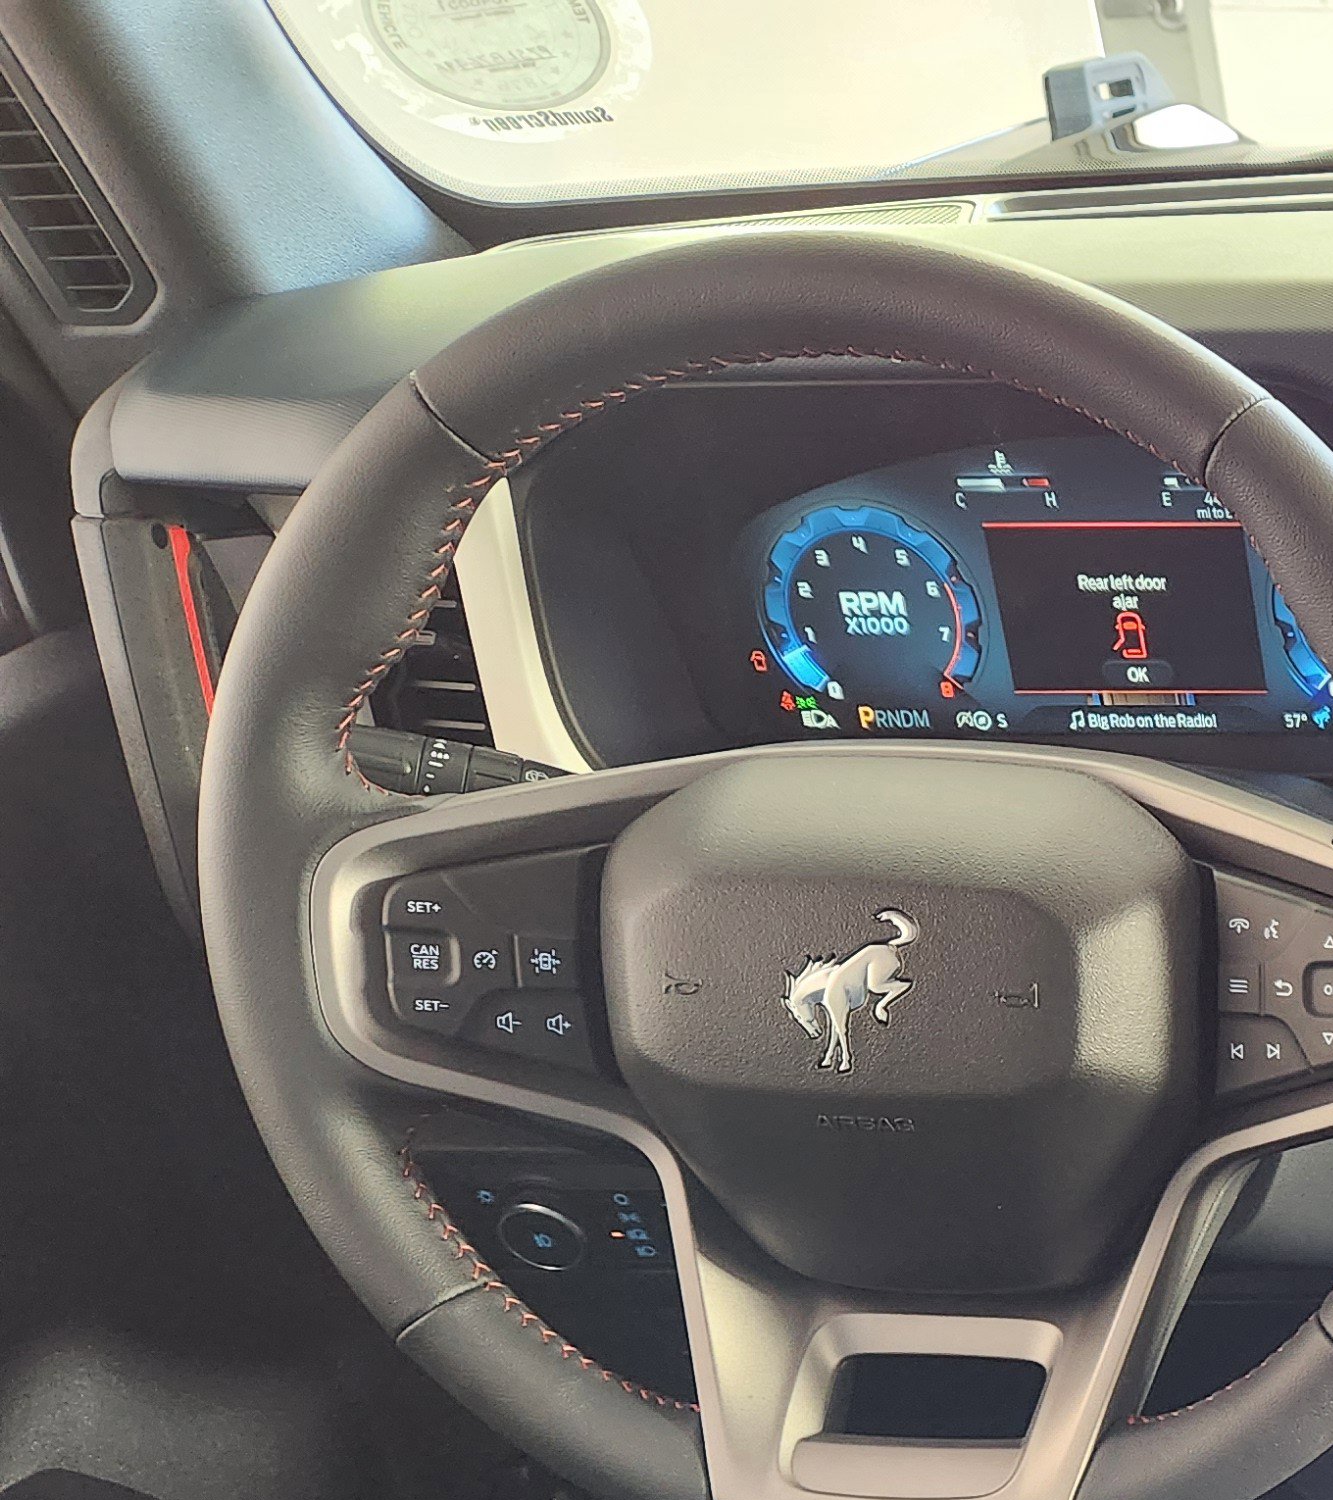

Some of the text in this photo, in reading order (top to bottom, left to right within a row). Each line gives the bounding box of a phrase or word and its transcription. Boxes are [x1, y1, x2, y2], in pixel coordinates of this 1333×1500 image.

[955, 492, 968, 510] C
[1044, 492, 1060, 510] H
[1162, 492, 1173, 508] E
[852, 536, 868, 554] 4
[814, 549, 830, 567] 3
[895, 549, 910, 567] 5
[797, 581, 814, 598] 2
[925, 581, 940, 598] 6
[1076, 574, 1167, 592] Rear left door
[838, 591, 908, 617] RPM
[1112, 594, 1139, 611] ajar
[804, 626, 817, 644] 1
[844, 617, 910, 636] X1000
[939, 627, 951, 642] 7
[1126, 667, 1150, 684] OK
[940, 681, 955, 698] 8
[1087, 712, 1109, 730] Big
[1110, 712, 1135, 729] Rob
[1136, 714, 1153, 728] on
[1153, 712, 1176, 729] the
[410, 944, 440, 956] CAN
[413, 958, 439, 971] RES
